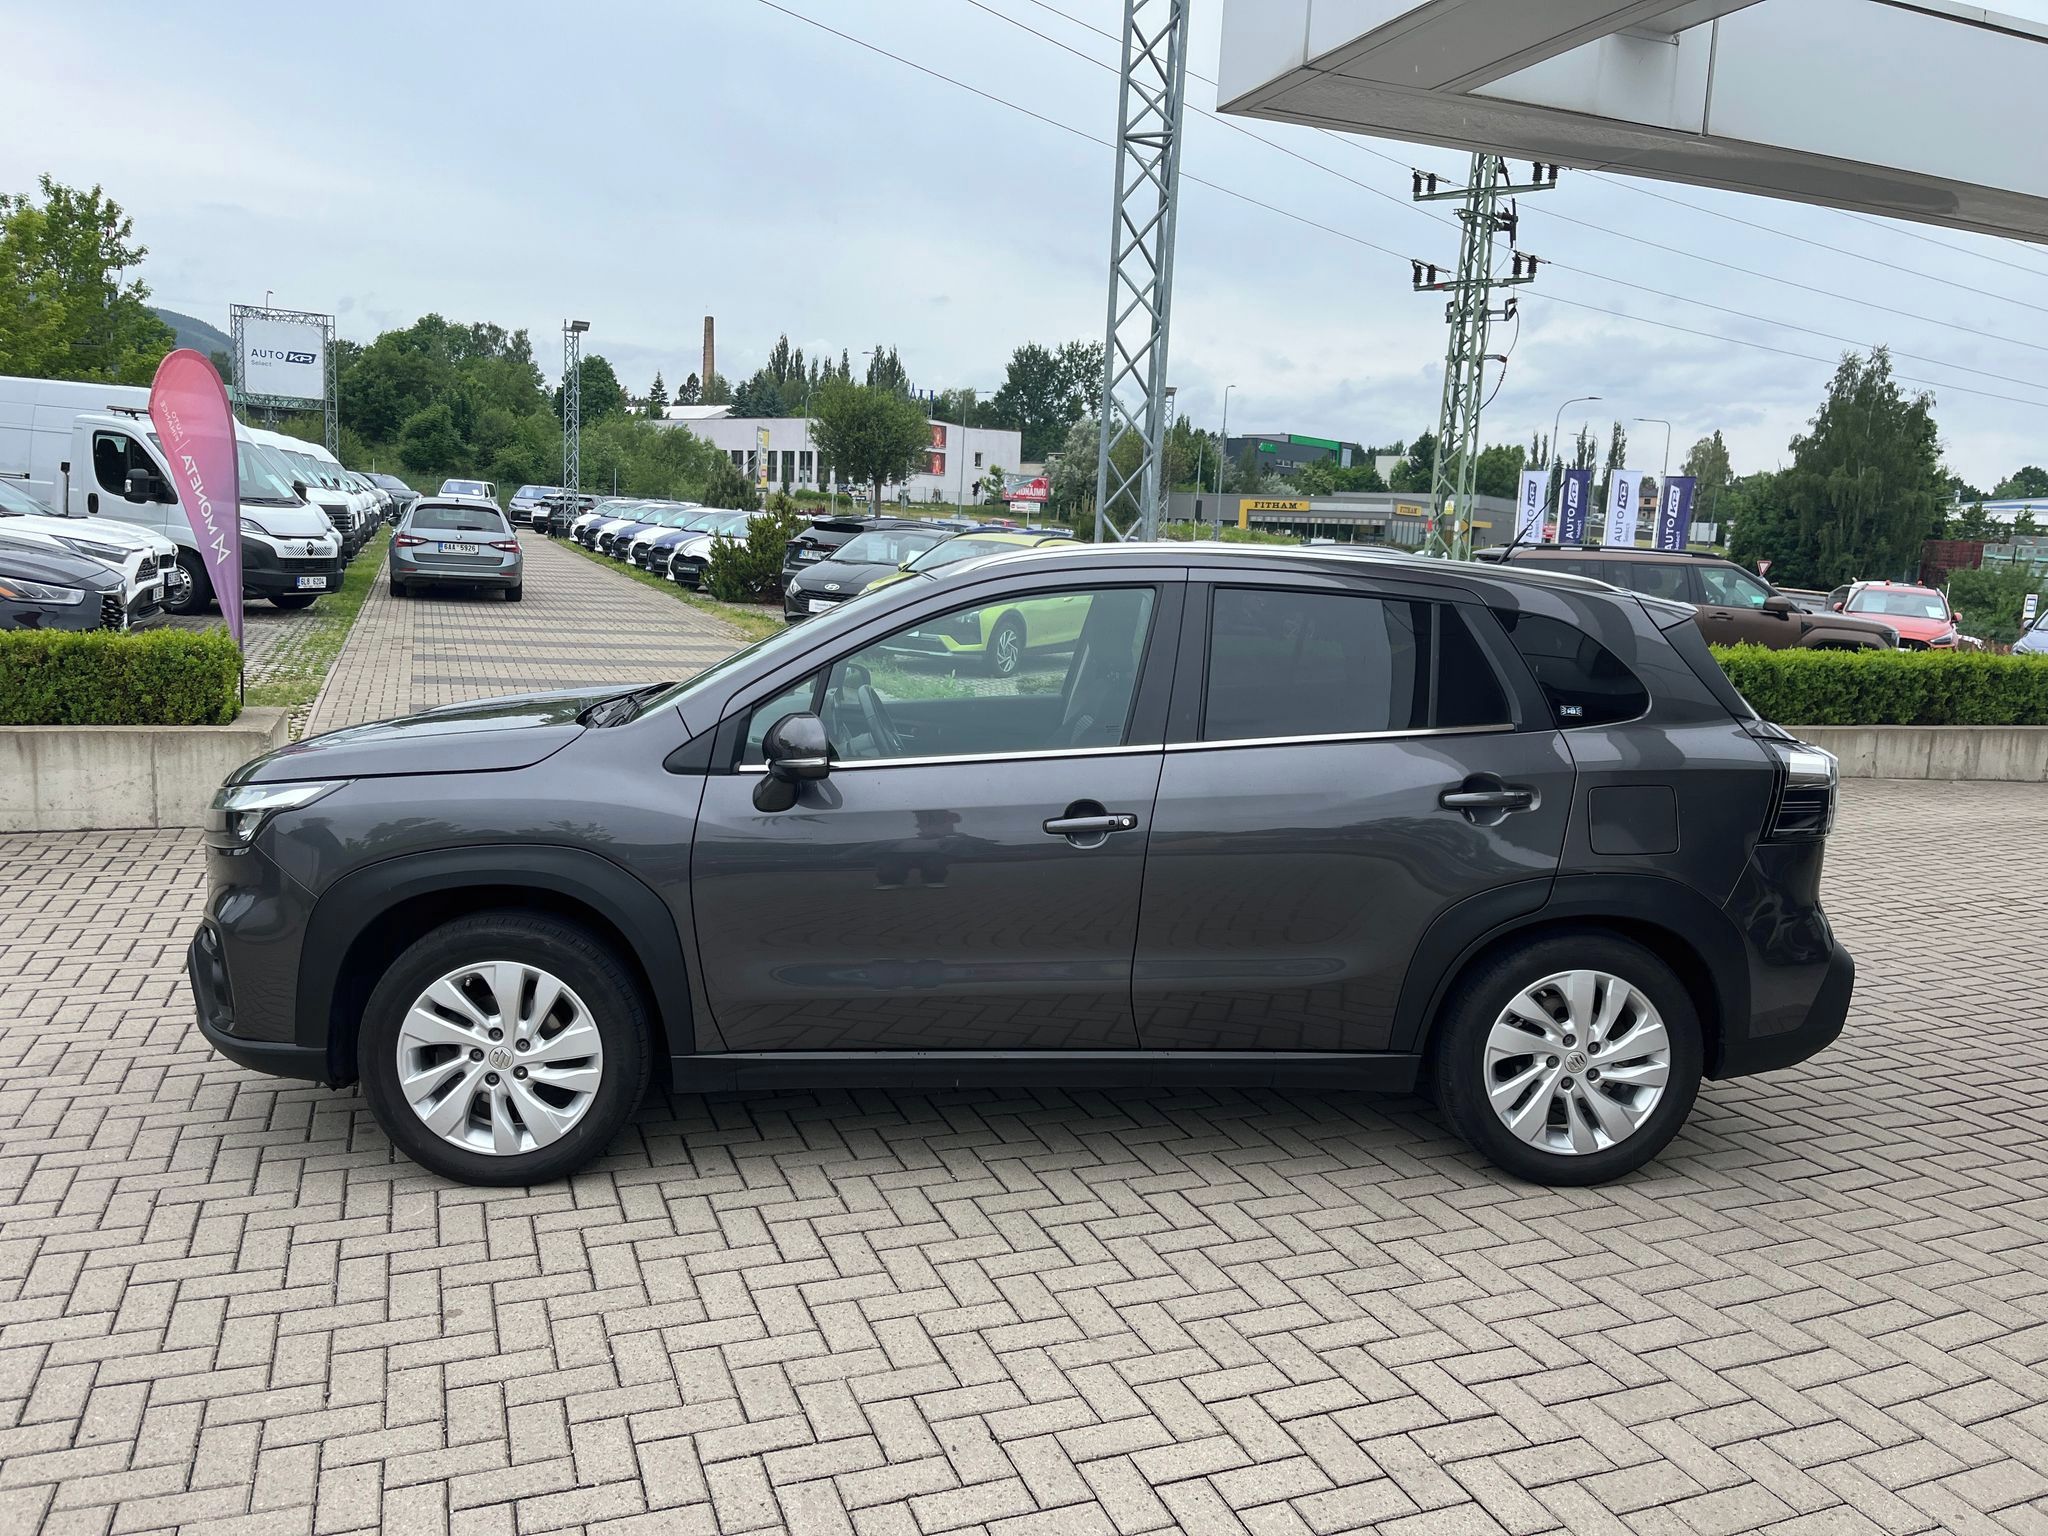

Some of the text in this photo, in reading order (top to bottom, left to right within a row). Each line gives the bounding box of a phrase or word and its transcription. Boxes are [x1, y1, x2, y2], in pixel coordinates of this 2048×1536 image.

[251, 349, 284, 360] AUTO
[1254, 501, 1298, 509] FITHAM
[1566, 508, 1575, 539] AUTO
[1614, 511, 1624, 542] AUTO
[1665, 518, 1675, 550] AUTO
